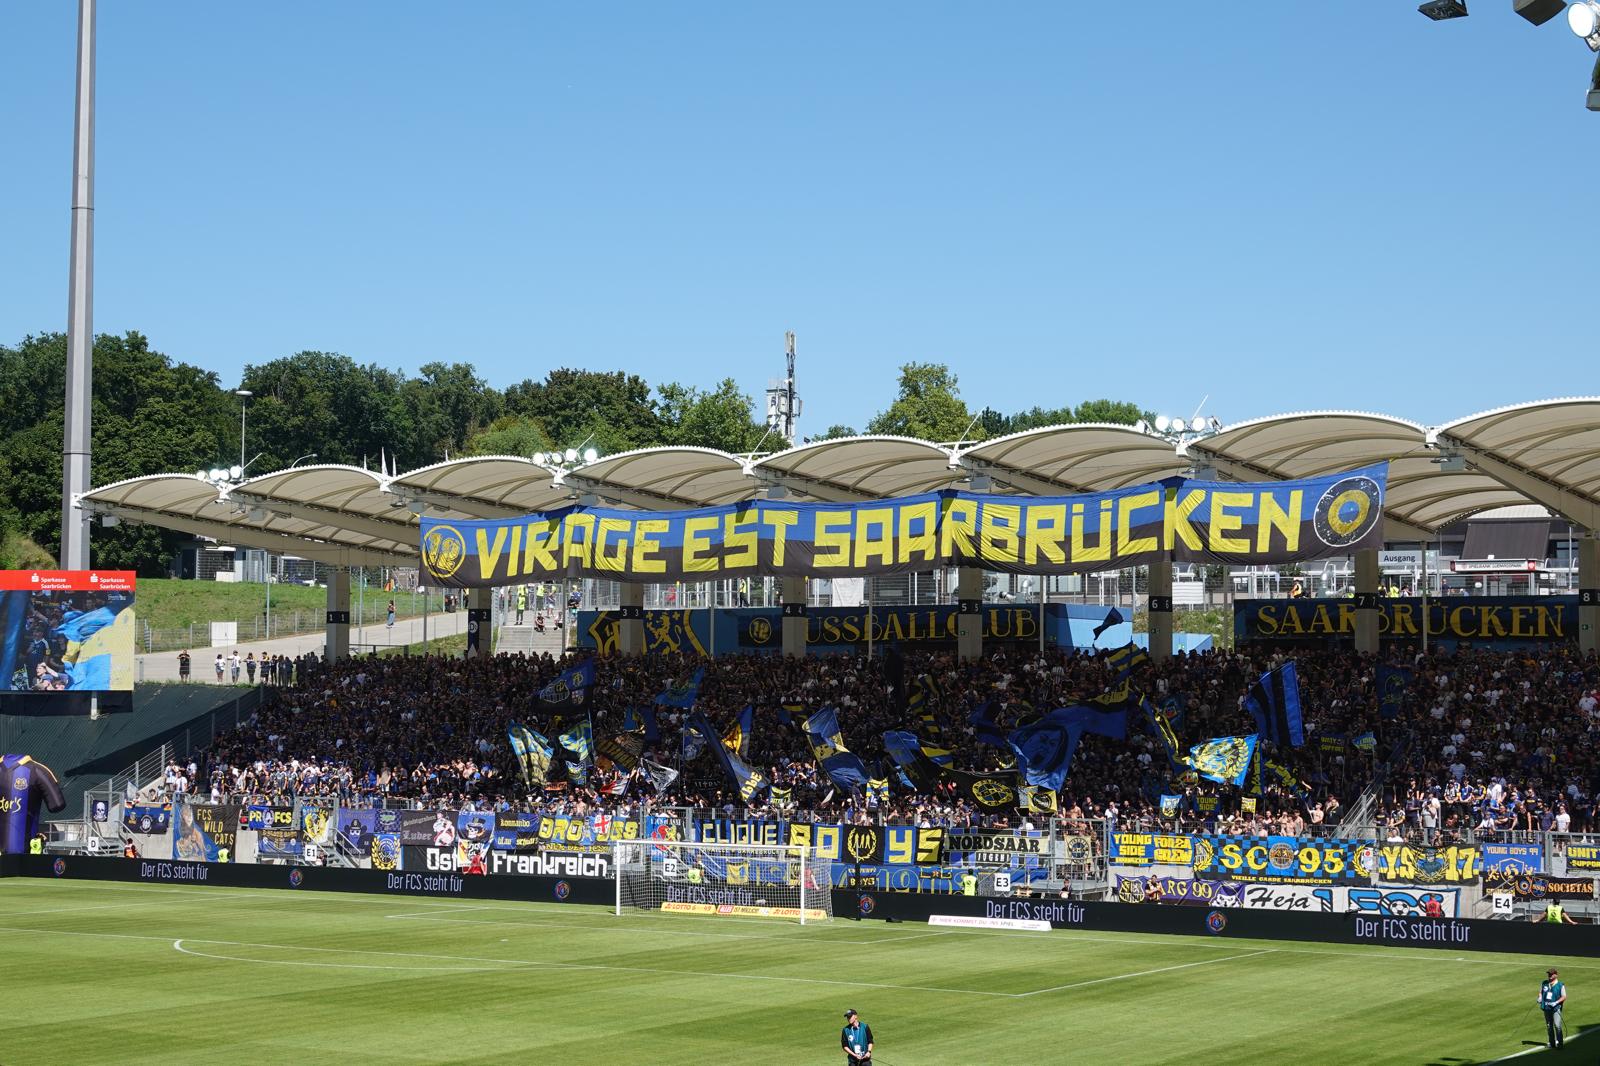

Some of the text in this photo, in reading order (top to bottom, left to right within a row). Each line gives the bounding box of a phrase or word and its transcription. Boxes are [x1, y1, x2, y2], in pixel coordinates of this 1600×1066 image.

[476, 513, 670, 579] VIRAGE
[682, 508, 798, 572] EST
[813, 489, 1303, 568] SAARBRÜCKEN
[1358, 596, 1365, 606] 7
[1583, 593, 1590, 602] 8
[962, 603, 967, 612] 5
[1152, 600, 1158, 608] 6
[622, 608, 628, 616] 3
[197, 809, 212, 820] FCS
[274, 812, 292, 824] FCS
[204, 821, 224, 833] WILD
[214, 834, 234, 846] CATS
[702, 824, 777, 844] CLIQUE
[1114, 834, 1152, 844] YOUNG
[949, 836, 1040, 852] NORDSAAR
[1120, 845, 1146, 856] SIDE
[1568, 847, 1600, 858] UNIT
[492, 852, 608, 877] Frankreich
[1220, 844, 1344, 873] SC 95
[1380, 846, 1476, 881] YS 17
[142, 862, 208, 880] Der FCS steht für
[665, 864, 676, 872] E2
[388, 874, 463, 892] Der FCS steht für
[996, 878, 1009, 886] E3
[1548, 882, 1594, 893] SOCIETAS
[666, 886, 753, 906] Der FCS steht für
[1192, 882, 1212, 898] 99
[1246, 887, 1310, 910] Heja
[1495, 898, 1510, 908] E4
[987, 900, 1085, 923] Der FCS steht für
[1355, 918, 1470, 942] Der FCS steht für
